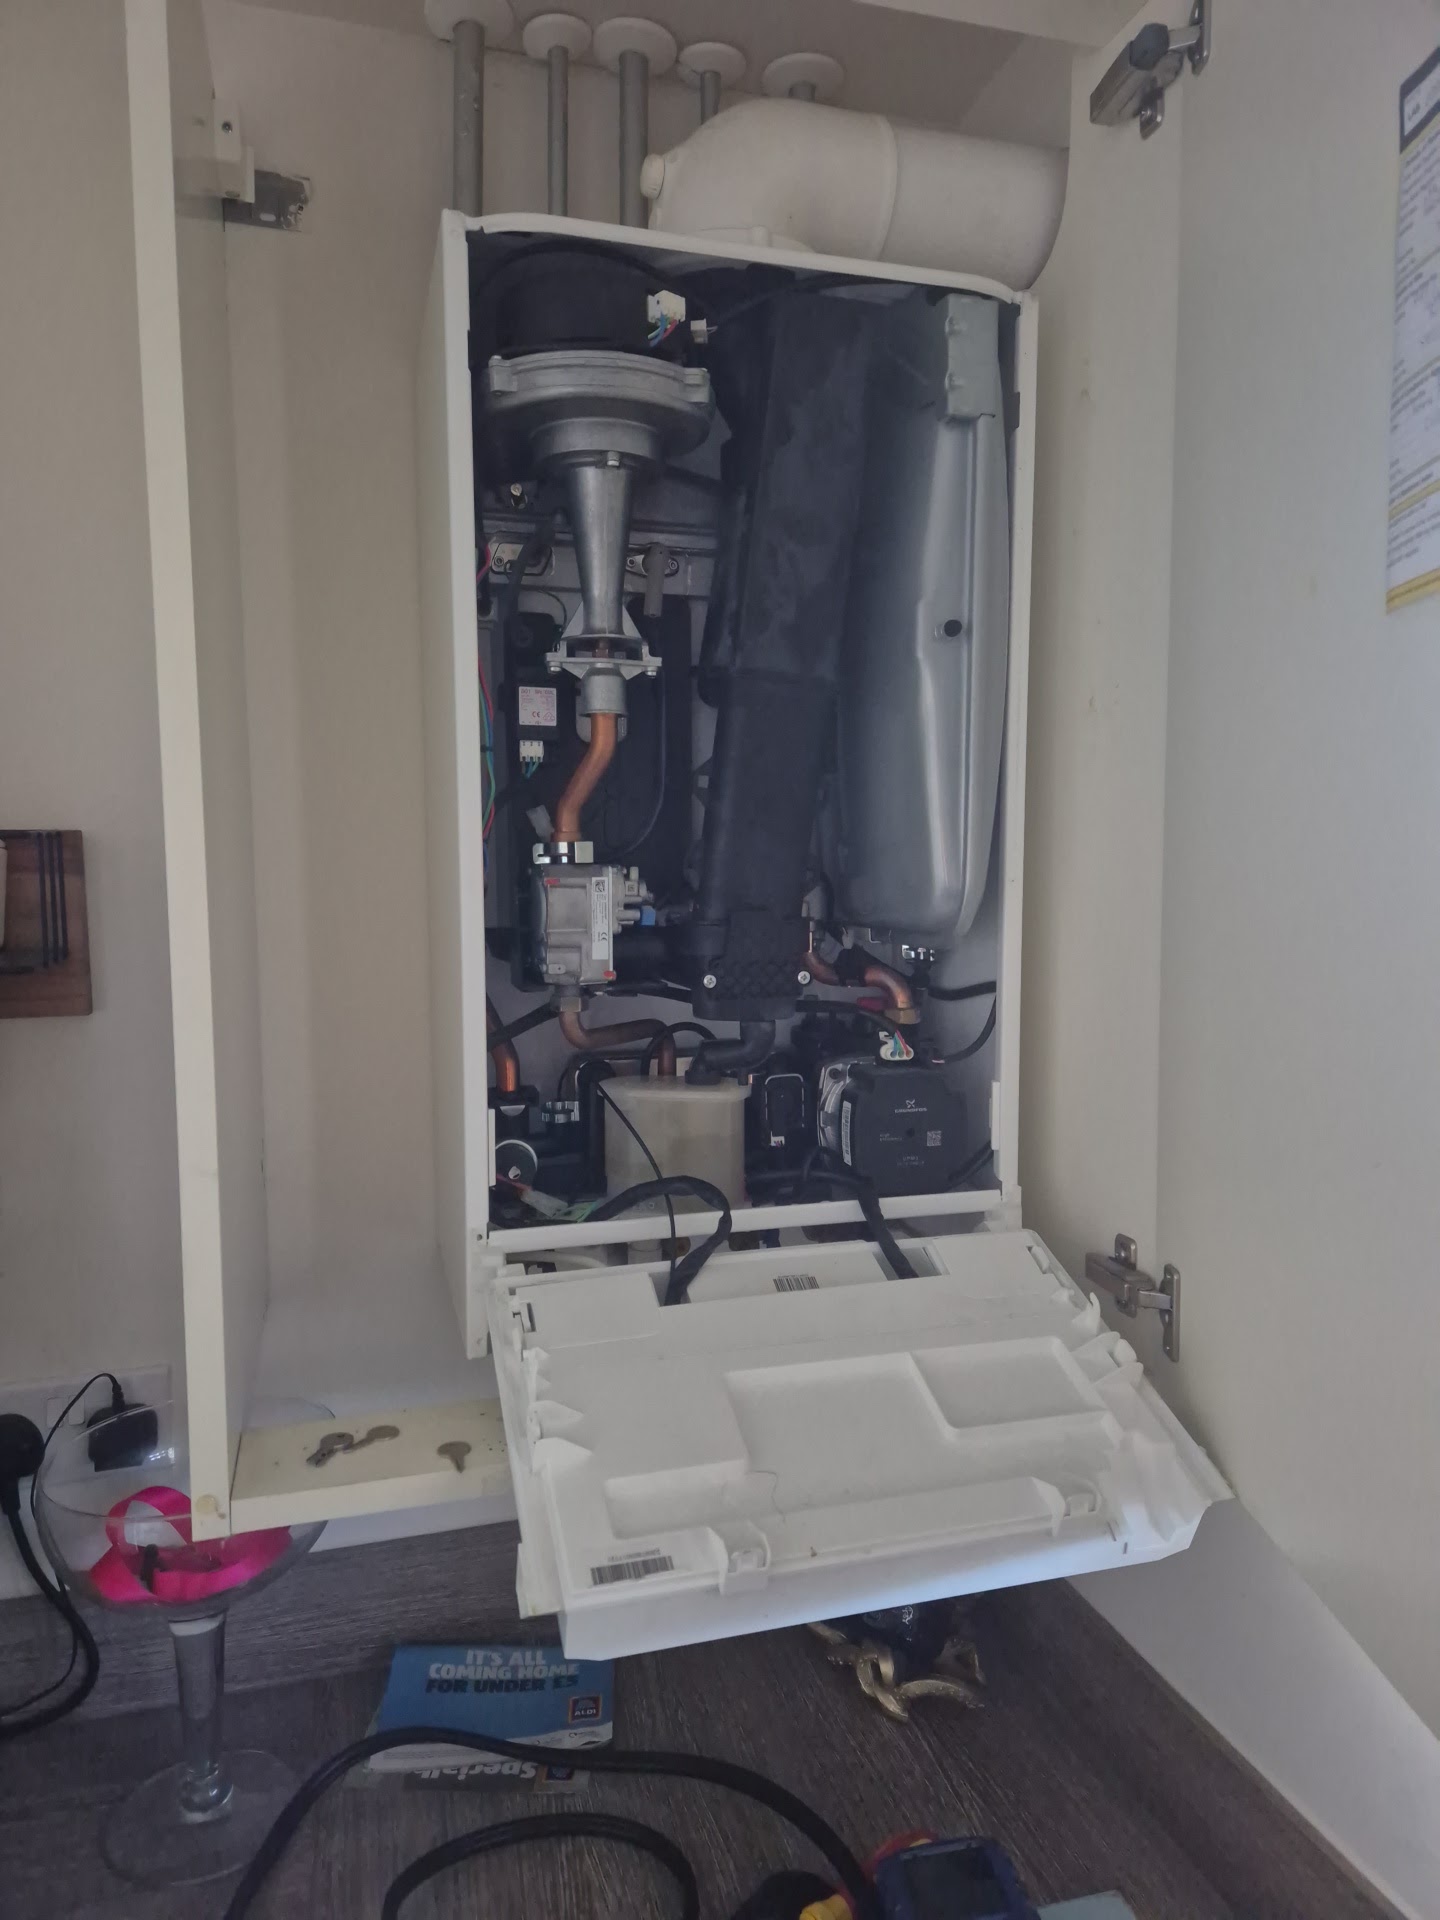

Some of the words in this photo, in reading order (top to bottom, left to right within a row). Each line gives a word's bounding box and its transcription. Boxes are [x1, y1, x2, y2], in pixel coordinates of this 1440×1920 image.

[466, 1650, 502, 1666] IT'S
[509, 1650, 546, 1666] ALL
[430, 1664, 512, 1679] COMING
[519, 1663, 579, 1679] HOME
[426, 1679, 468, 1693] FOR
[473, 1678, 546, 1693] UNDER
